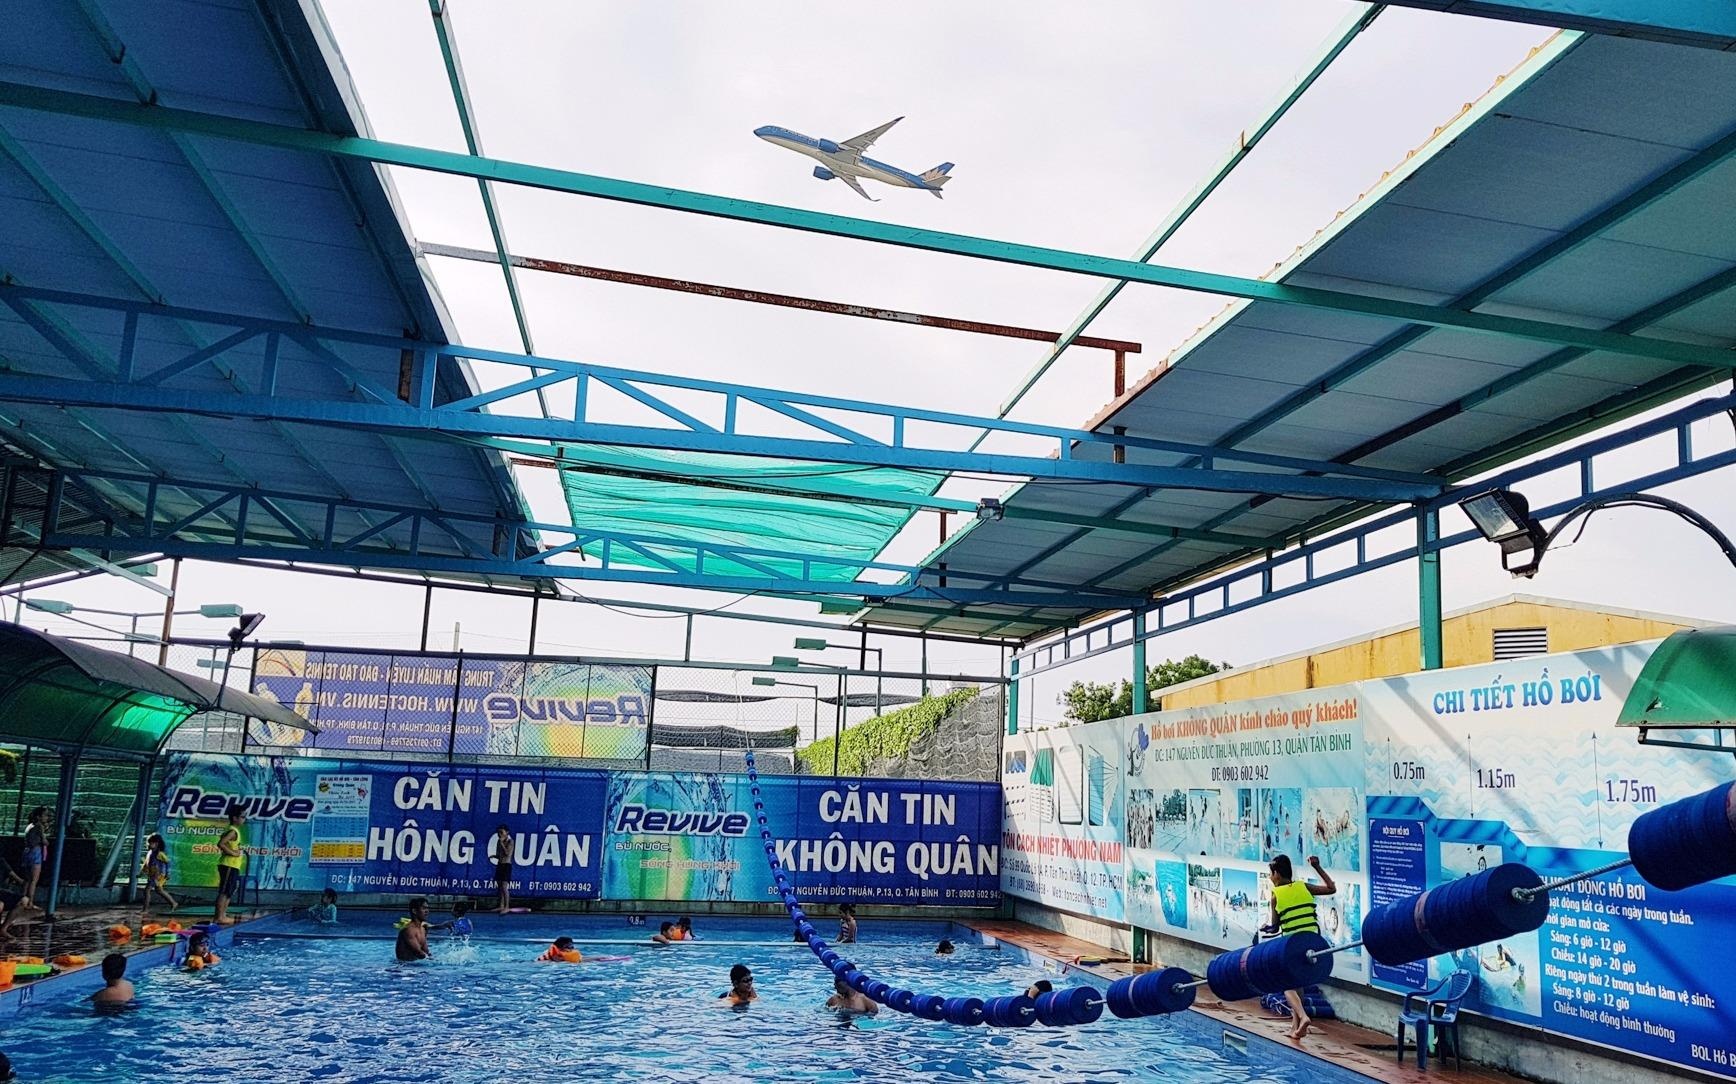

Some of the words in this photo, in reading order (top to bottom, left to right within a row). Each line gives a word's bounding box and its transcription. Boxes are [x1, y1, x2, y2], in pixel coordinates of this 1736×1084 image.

[1433, 689, 1465, 714] CHI
[1470, 675, 1516, 710] TIẾT
[1522, 668, 1554, 707] HỒ
[1561, 670, 1602, 704] BƠI
[1177, 715, 1208, 738] KHÔNG
[1210, 711, 1237, 739] QUÂN
[1240, 710, 1262, 730] kính
[1265, 707, 1288, 728] chào
[1291, 703, 1312, 729] quý
[1316, 698, 1357, 722] khách!
[1166, 747, 1175, 761] 147
[1273, 739, 1284, 756] 13,
[1285, 732, 1308, 757] QUẬN
[1310, 731, 1326, 753] TÂN
[1329, 729, 1351, 752] BÌNH
[1211, 767, 1220, 781] ĐT:
[1222, 766, 1239, 781] 0903
[1240, 765, 1253, 780] 602
[1256, 765, 1269, 780] 942
[1393, 762, 1425, 780] 0.75m
[1477, 769, 1516, 789] 1.15m
[168, 786, 314, 821] Revive
[393, 770, 472, 812] CĂN
[485, 779, 546, 815] TIN
[819, 784, 889, 823] CĂN
[900, 793, 956, 825] TIN
[1606, 779, 1657, 803] 1.75m
[615, 804, 749, 836] Revive
[192, 843, 220, 854] SỐN
[367, 818, 475, 865] HÔNG
[615, 840, 631, 850] BÙ
[775, 831, 895, 873] KHÔNG
[906, 835, 998, 880] QUÂN
[1003, 828, 1016, 850] TÔN
[1100, 841, 1121, 864] NAM
[331, 874, 346, 884] ĐC:
[364, 872, 398, 885] NGUYỄN
[400, 875, 418, 886] ĐỨC
[452, 878, 471, 890] P.13,
[473, 879, 481, 889] Q.
[529, 881, 542, 891] ĐT:
[543, 882, 561, 891] 0903
[563, 882, 576, 891] 602
[578, 882, 592, 892] 942
[797, 882, 828, 895] NGUYỄN
[830, 884, 846, 896] ĐỨC
[877, 888, 893, 898] P.13,
[895, 888, 903, 897] Q.
[905, 886, 919, 897] TÂN
[921, 887, 939, 898] BÌNH
[946, 889, 958, 898] ĐT:
[959, 889, 975, 898] 0903
[976, 889, 988, 898] 602
[1577, 878, 1606, 896] ĐỘNG
[1608, 876, 1625, 898] HỒ
[1627, 883, 1646, 901] BƠI
[1560, 914, 1577, 928] gian
[1579, 916, 1591, 929] mở
[1593, 918, 1610, 932] cửa:
[1561, 896, 1580, 912] động
[1582, 894, 1593, 911] tất
[1595, 900, 1604, 913] cả
[1606, 902, 1620, 915] các
[1622, 905, 1642, 920] ngày
[1644, 906, 1668, 925] trong
[1670, 909, 1694, 925] tuần.
[1550, 929, 1572, 946] Sáng:
[1573, 933, 1579, 945] 6
[1580, 935, 1593, 949] giờ
[1600, 937, 1611, 951] 12
[1613, 940, 1626, 955] giờ
[1551, 947, 1575, 962] Chiều:
[1577, 951, 1587, 965] 14
[1589, 955, 1602, 969] giờ
[1609, 957, 1620, 971] 20
[1622, 960, 1636, 975] giờ
[1545, 962, 1566, 981] Riêng
[1568, 969, 1587, 985] ngày
[1588, 971, 1602, 985] thứ
[1604, 974, 1610, 987] 2
[1612, 977, 1634, 995] trong
[1636, 981, 1656, 997] tuần
[1658, 985, 1676, 1001] làm
[1678, 990, 1689, 1006] vệ
[1691, 992, 1715, 1008] sinh:
[1553, 982, 1574, 1000] Sáng:
[1576, 986, 1581, 999] 8
[1583, 990, 1596, 1003] giờ
[1603, 992, 1614, 1007] 12
[1616, 996, 1630, 1011] giờ
[1553, 1000, 1578, 1016] Chiều:
[1580, 1005, 1598, 1023] hoạt
[1600, 1011, 1620, 1030] động
[1622, 1015, 1641, 1032] bình
[1643, 1020, 1675, 1043] thường
[1691, 1044, 1711, 1061] BQL
[1713, 1049, 1727, 1065] Hồ
